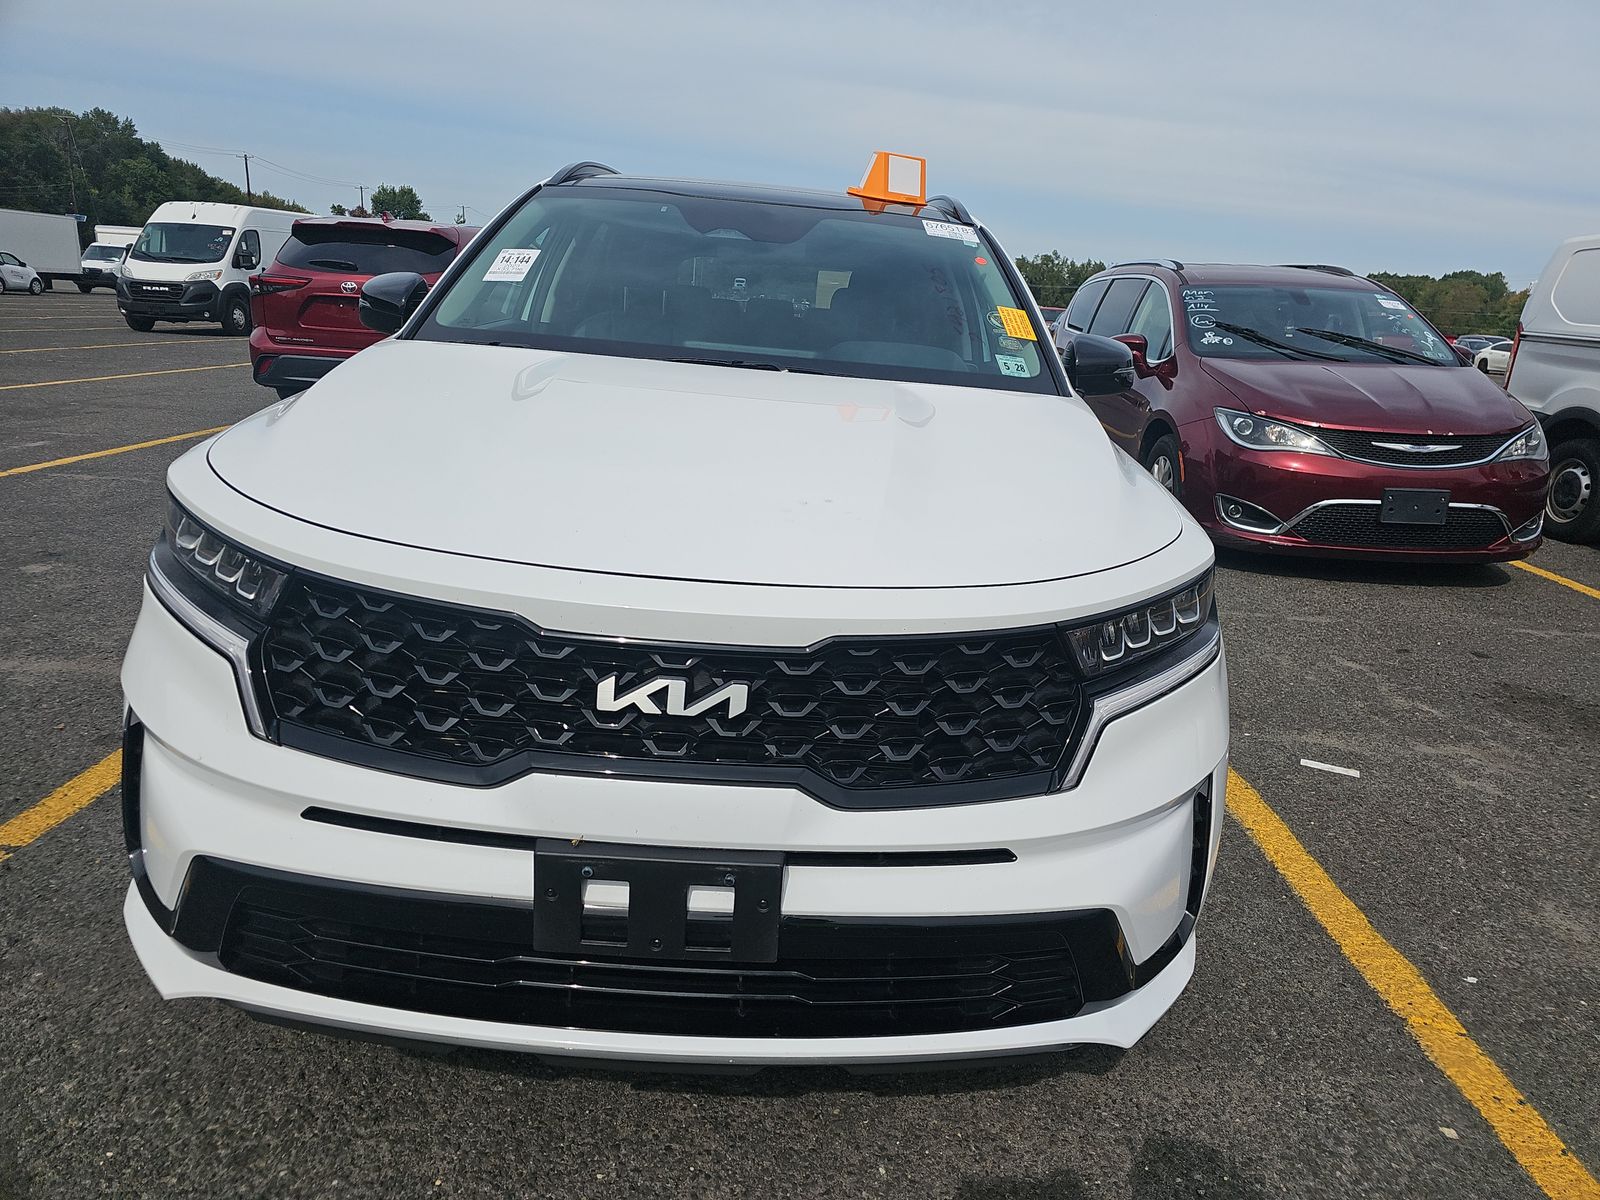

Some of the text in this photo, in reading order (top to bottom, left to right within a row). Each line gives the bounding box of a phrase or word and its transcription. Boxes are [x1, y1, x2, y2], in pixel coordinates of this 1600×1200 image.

[500, 255, 531, 264] 14:144
[1003, 361, 1026, 373] 5 28
[596, 674, 749, 719] KIA
